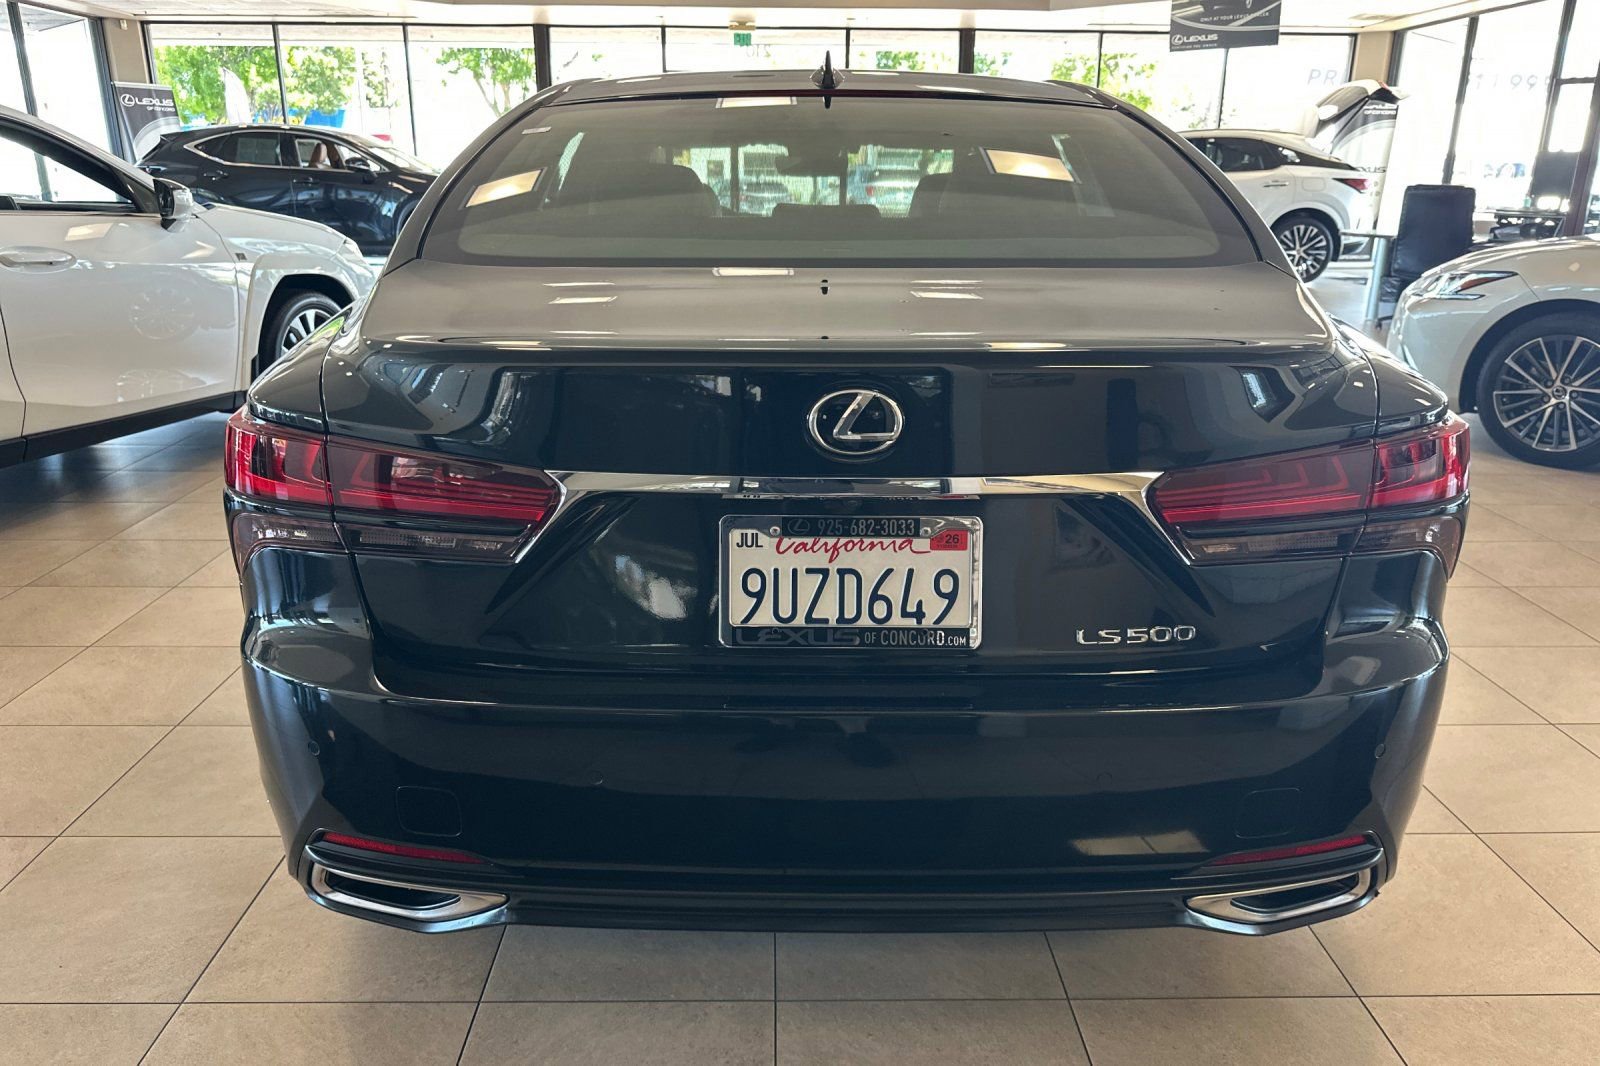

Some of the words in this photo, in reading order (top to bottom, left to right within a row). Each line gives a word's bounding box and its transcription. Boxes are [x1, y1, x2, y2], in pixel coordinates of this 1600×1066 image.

[1184, 34, 1218, 42] LEXUS
[135, 97, 174, 107] LEXUS
[817, 520, 915, 536] 925-682-3033
[736, 533, 764, 548] JUL
[945, 534, 960, 544] 26
[775, 537, 931, 563] California
[740, 568, 960, 625] 9UZD649
[736, 628, 861, 646] LEXUS
[864, 632, 877, 644] OF
